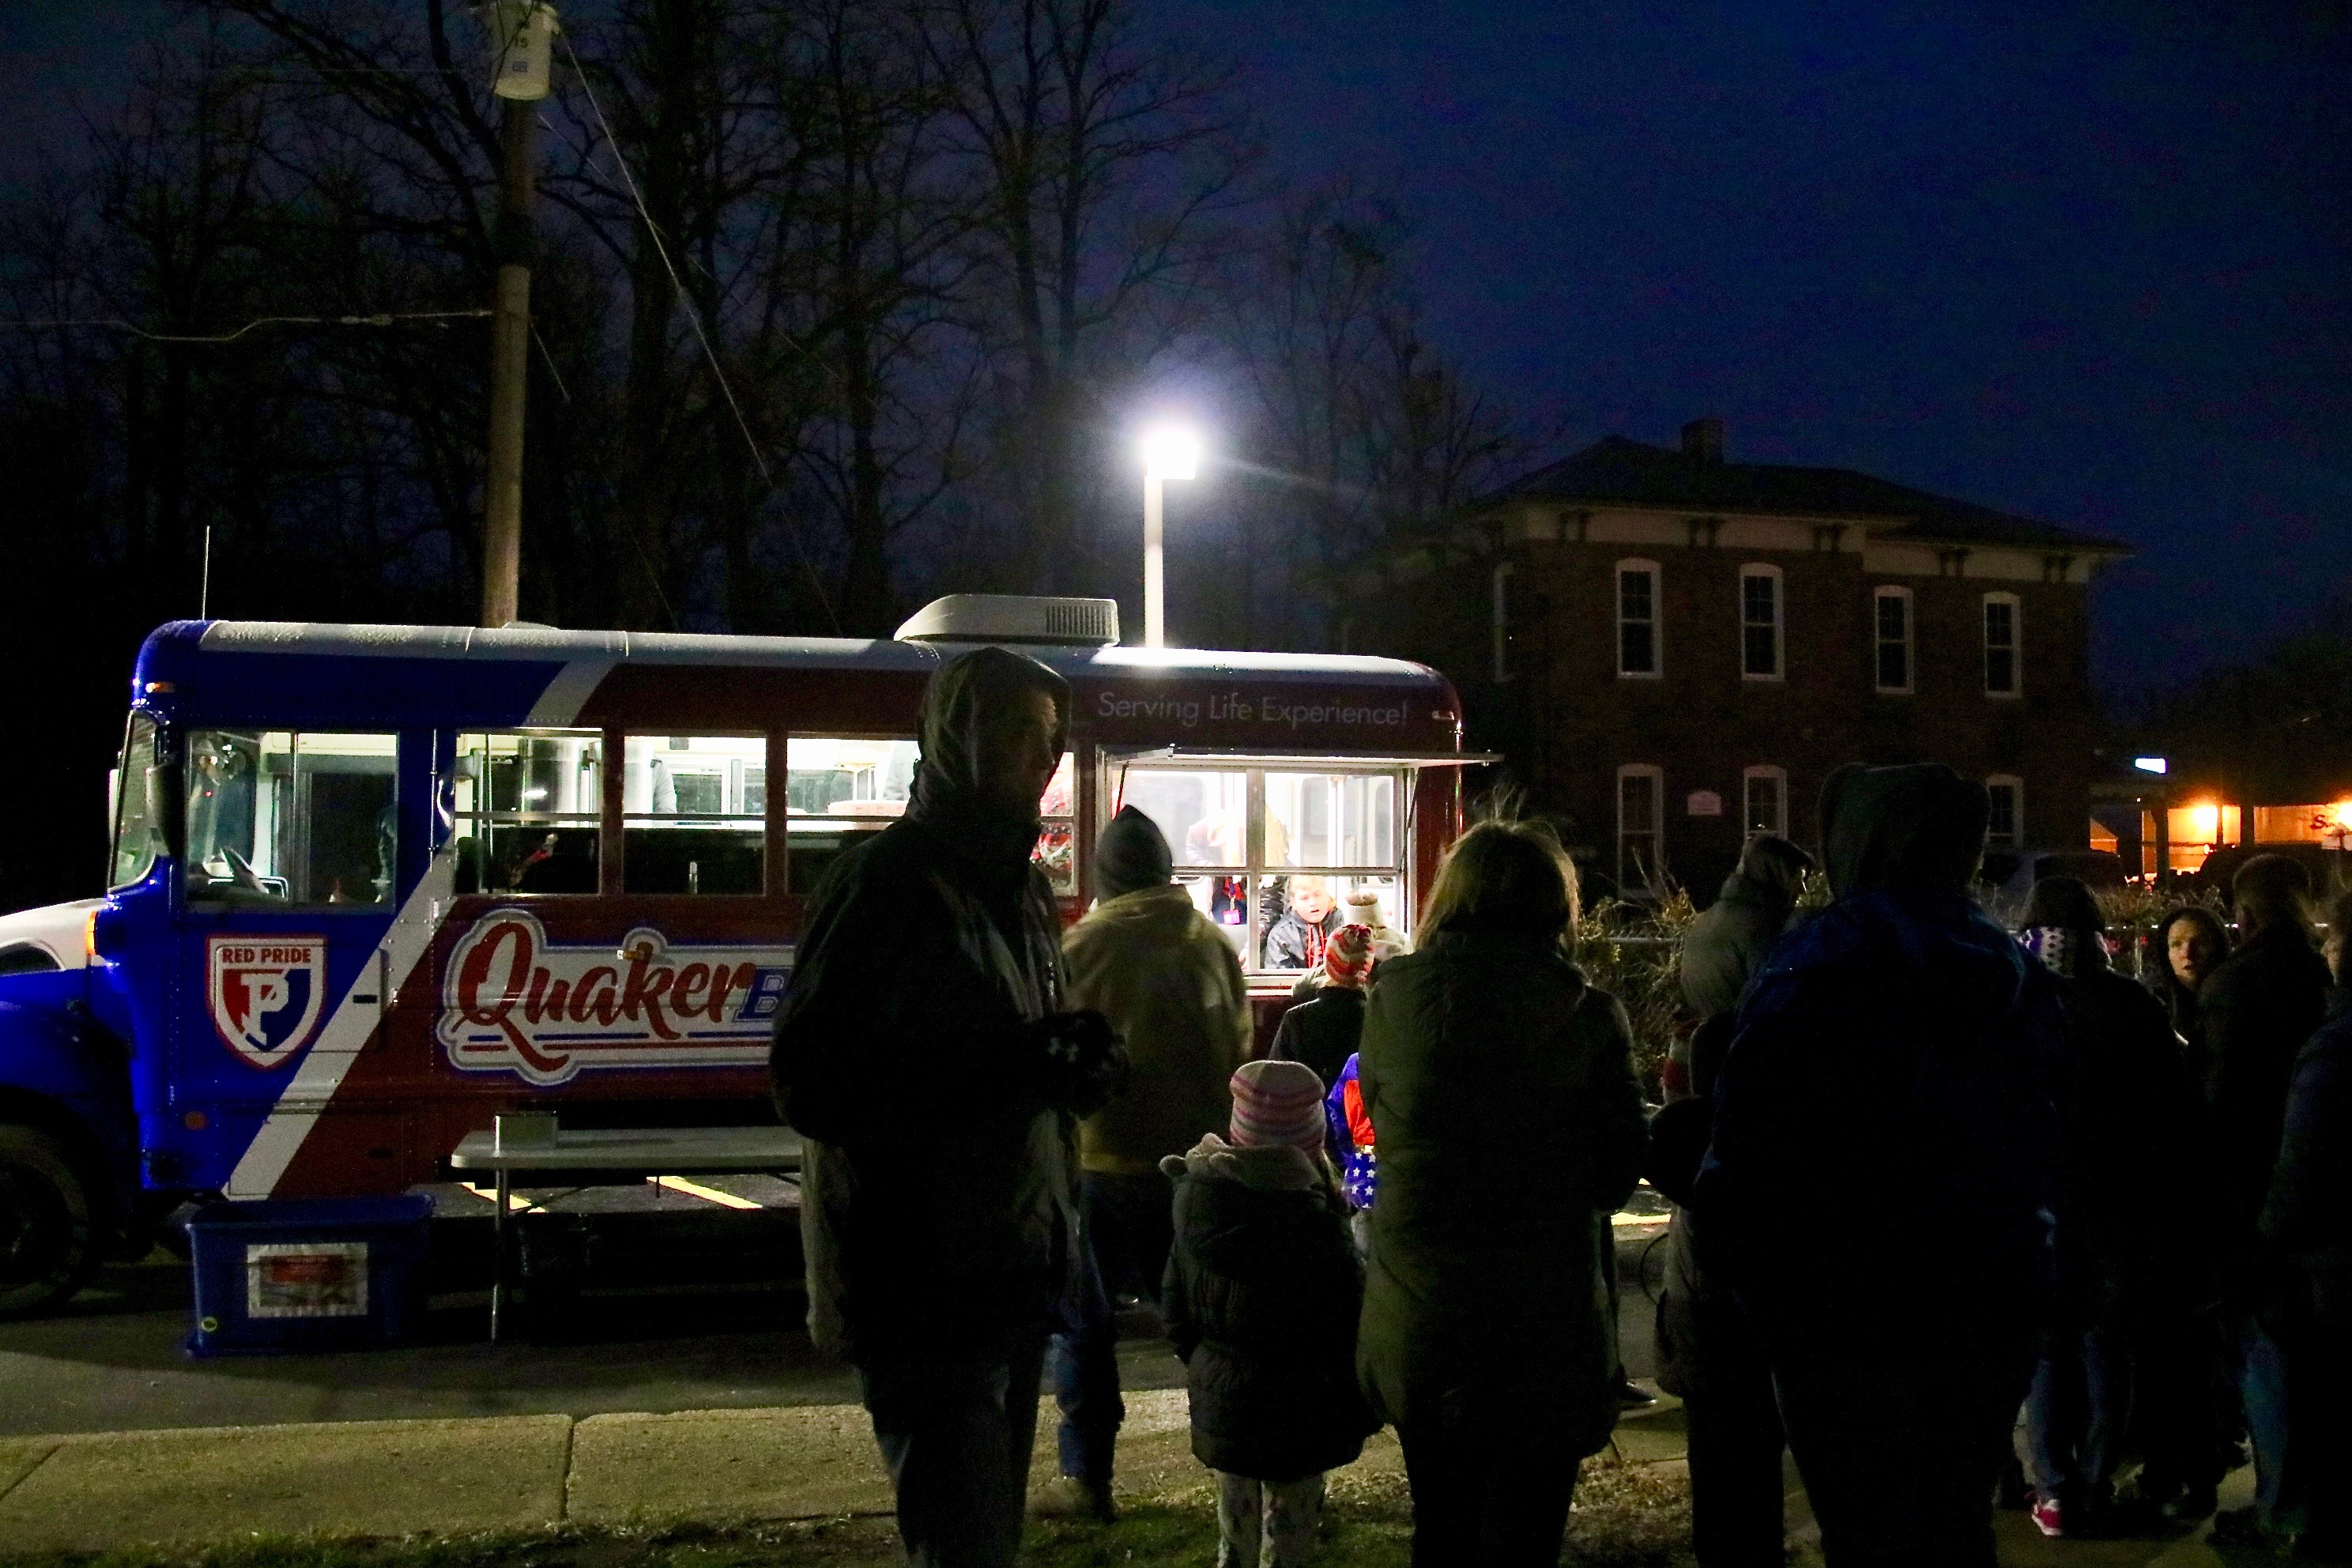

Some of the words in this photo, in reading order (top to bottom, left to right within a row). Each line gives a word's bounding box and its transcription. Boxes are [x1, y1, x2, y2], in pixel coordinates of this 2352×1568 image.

[1098, 691, 1200, 728] Serving
[1210, 692, 1252, 721] Life
[1263, 696, 1408, 729] Experience!
[222, 948, 254, 963] RED
[261, 948, 311, 963] PRIDE
[451, 921, 756, 1072] Quaker
